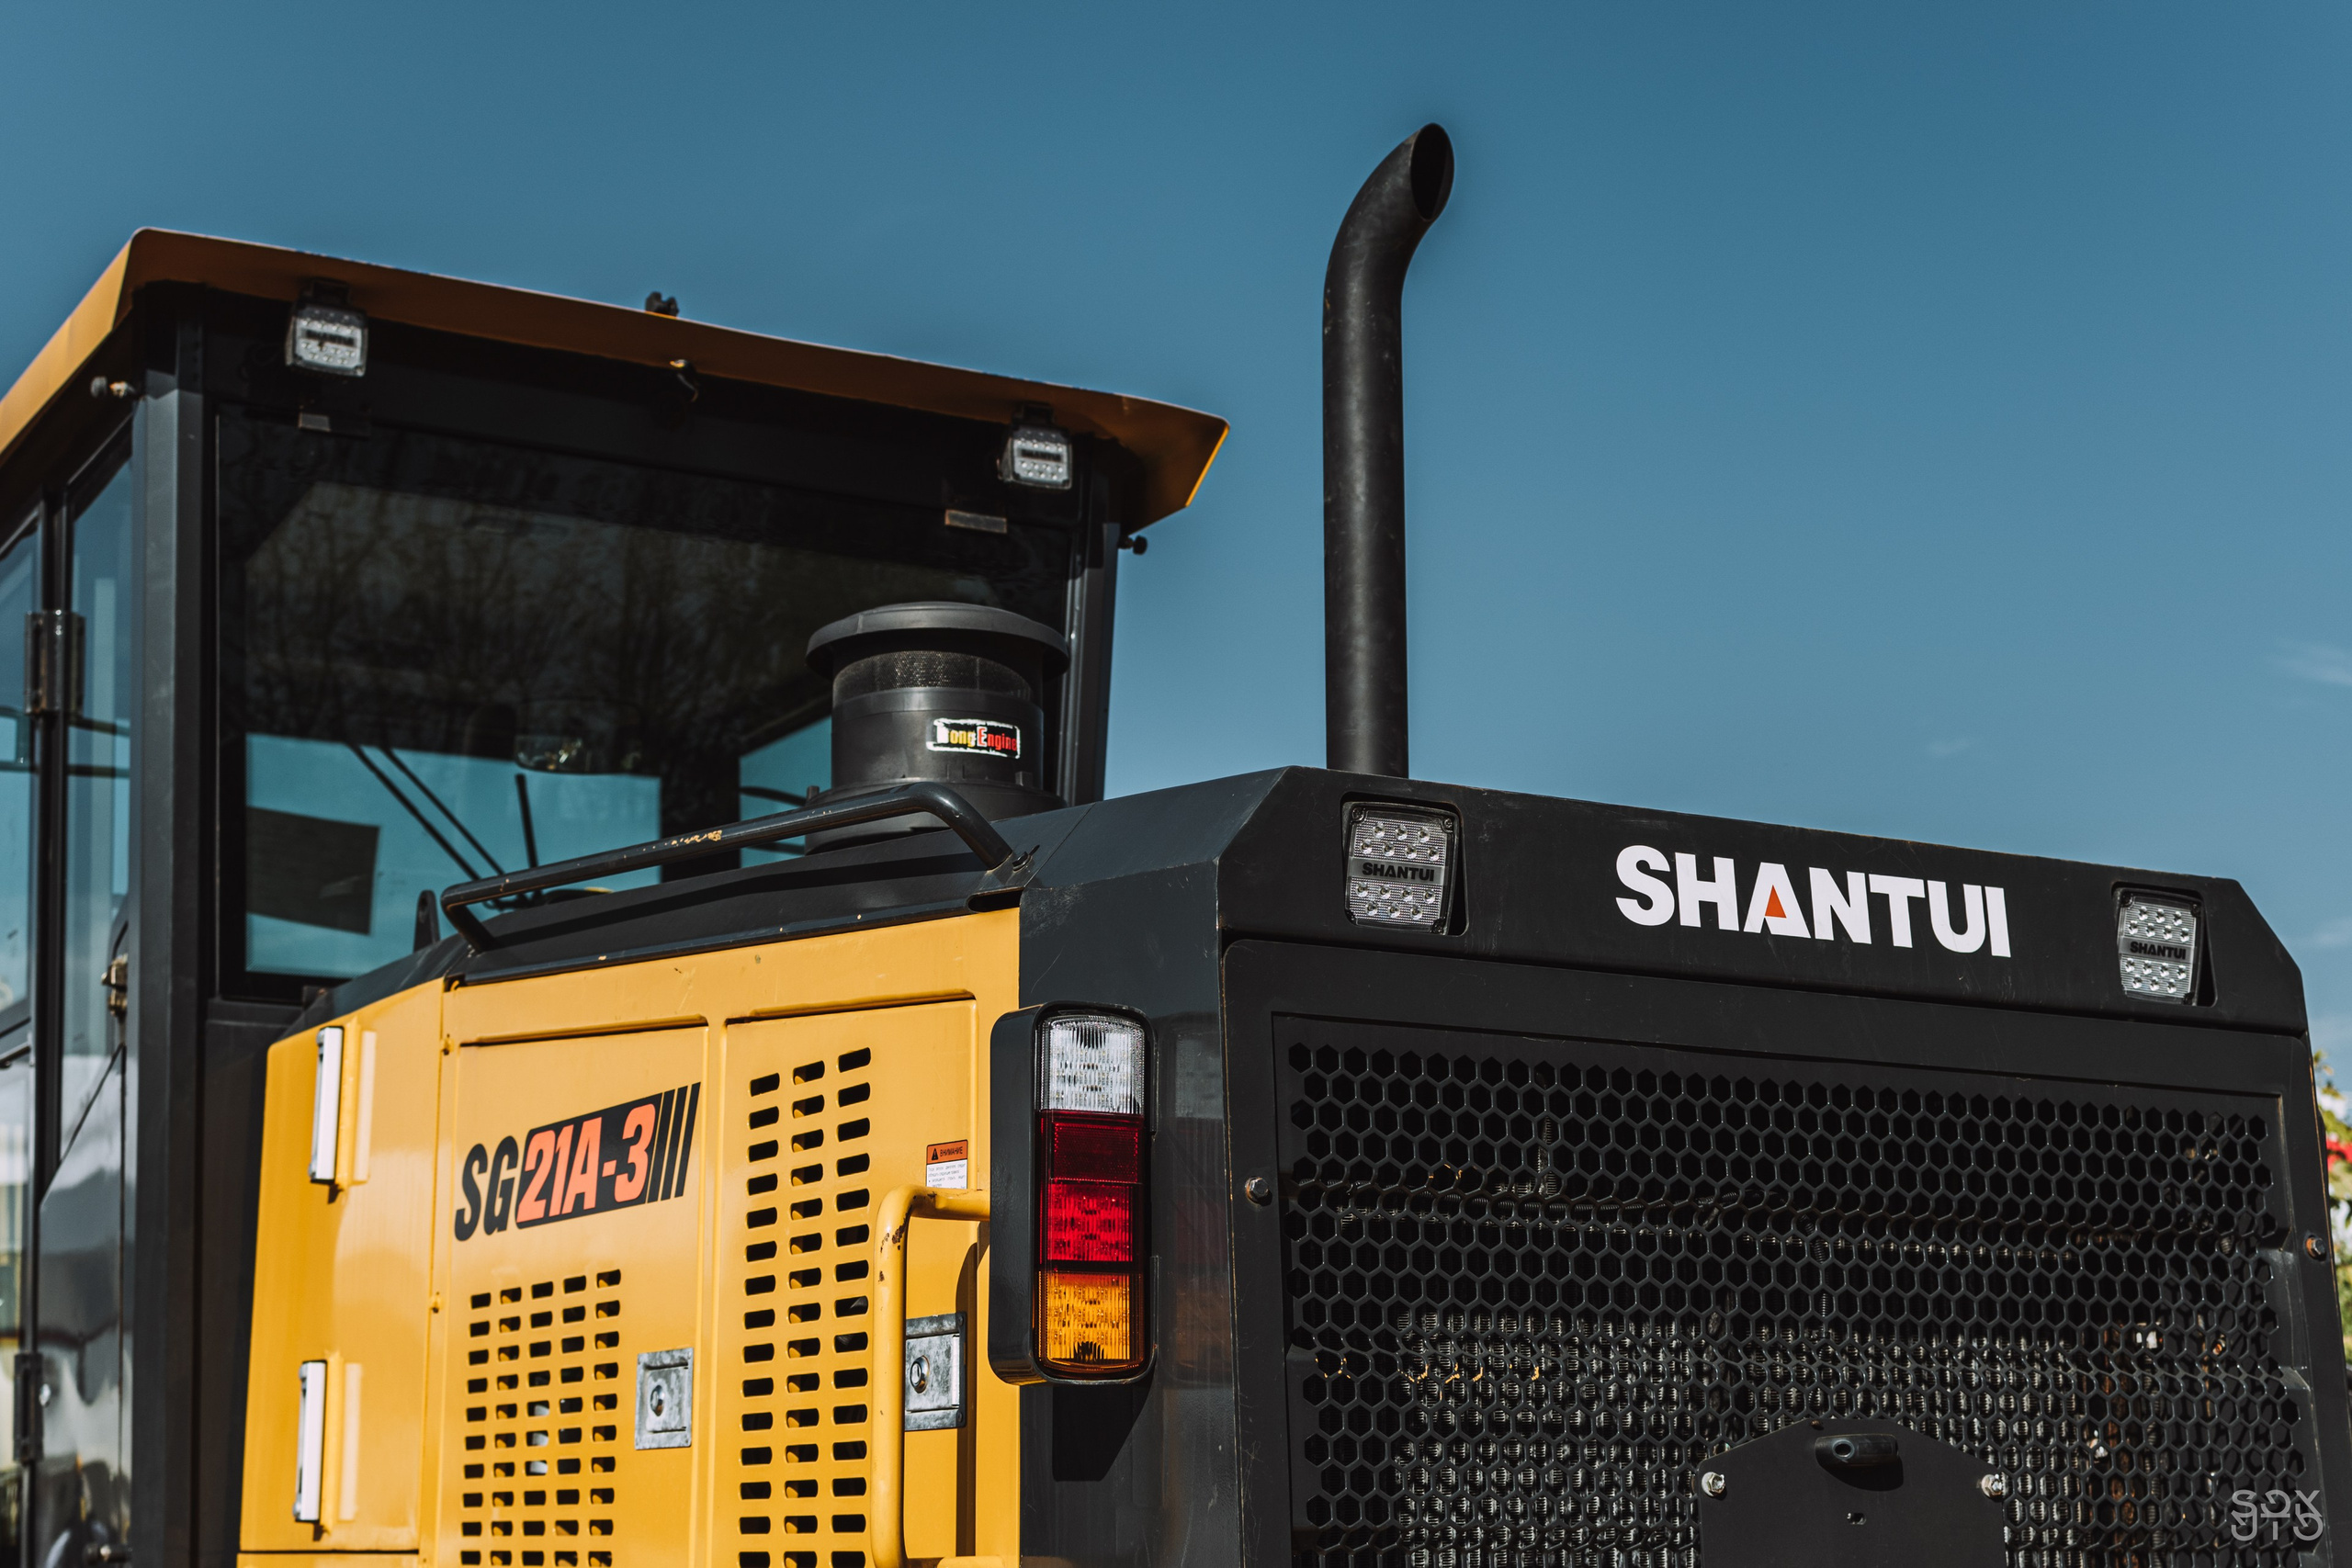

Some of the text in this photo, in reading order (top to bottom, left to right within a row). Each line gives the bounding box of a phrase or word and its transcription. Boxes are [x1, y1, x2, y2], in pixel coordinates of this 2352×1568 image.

[1362, 862, 1435, 882] SHANTUI
[1615, 845, 2011, 958] SHANTUI
[2130, 941, 2187, 960] SHANTUI
[454, 1103, 656, 1242] SG21A-3
